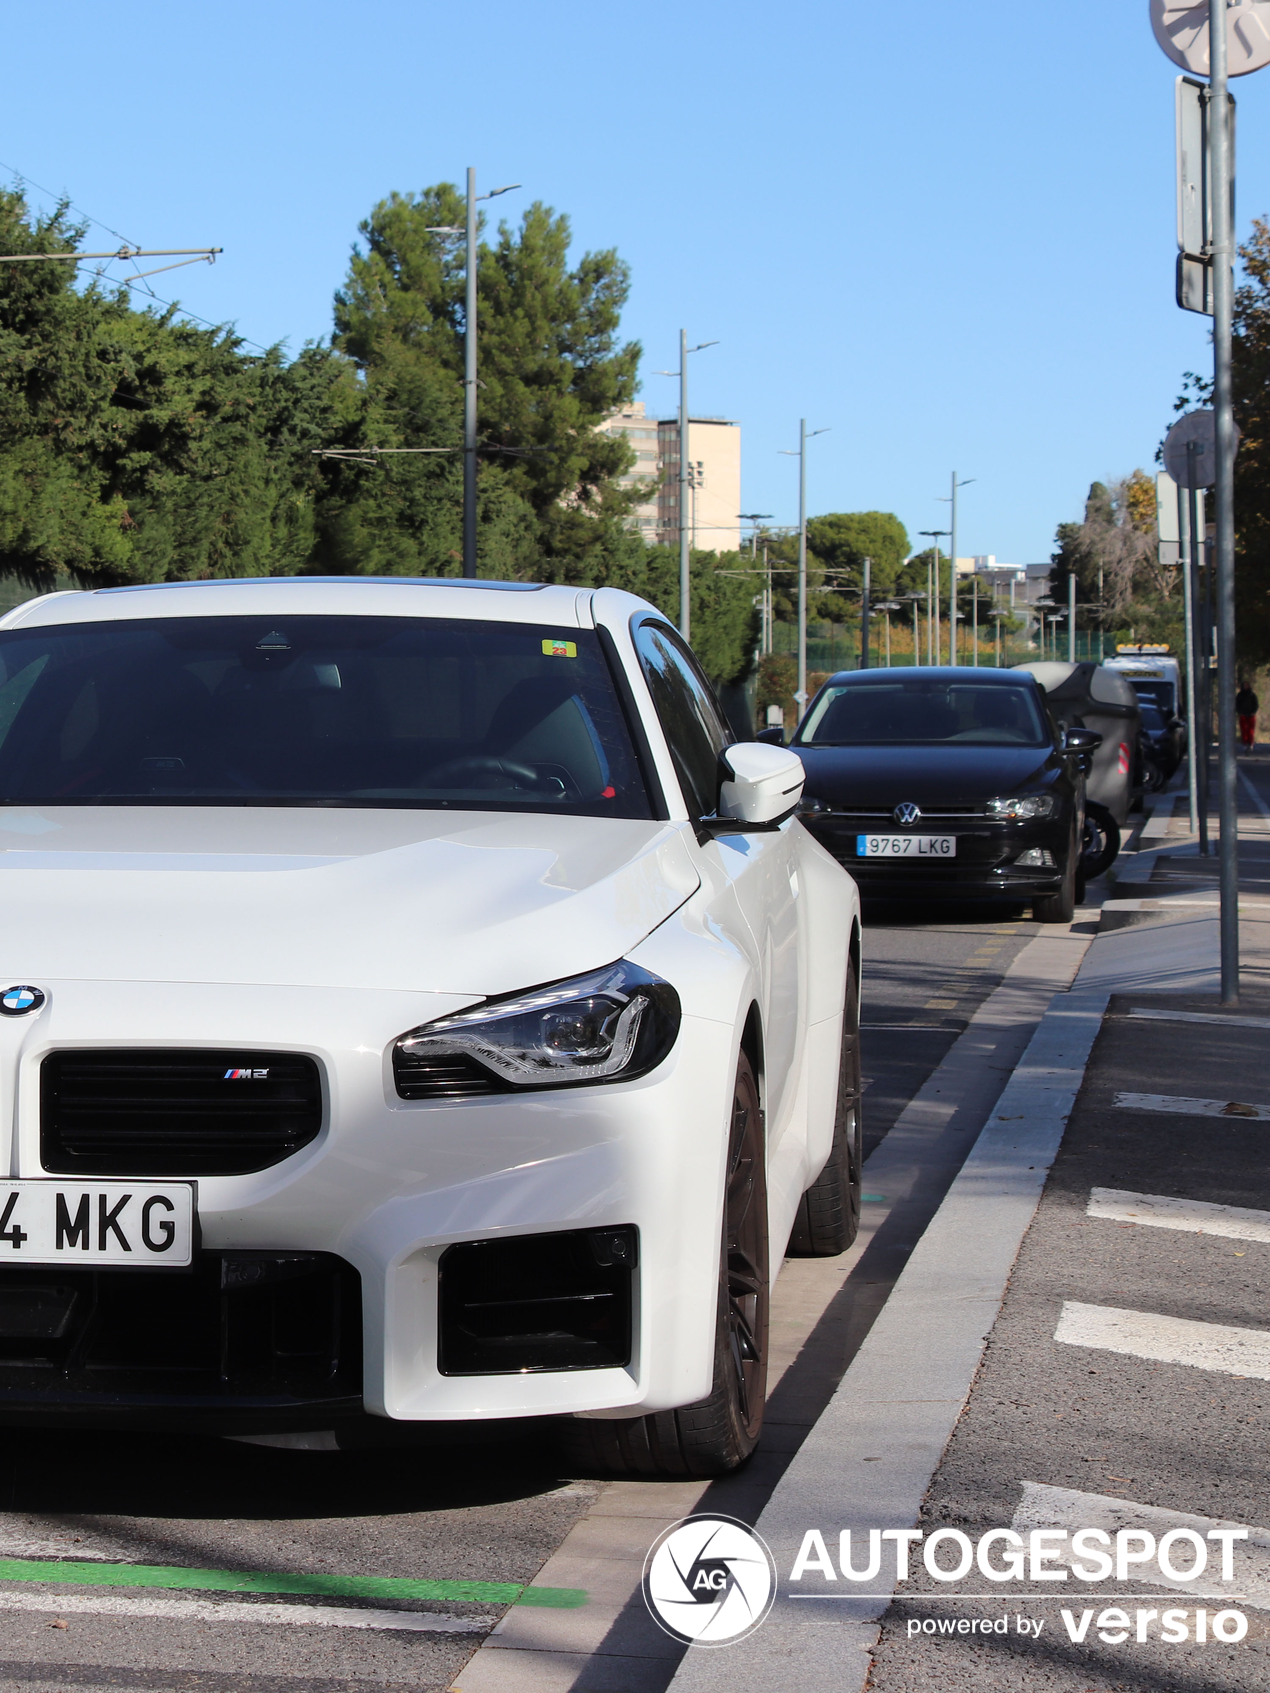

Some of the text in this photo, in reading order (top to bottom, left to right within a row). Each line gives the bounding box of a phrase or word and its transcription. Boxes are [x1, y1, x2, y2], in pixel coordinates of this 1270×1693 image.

[552, 647, 567, 655] 23
[870, 839, 951, 854] 9767 LKG
[234, 1068, 269, 1079] M2
[55, 1192, 175, 1252] MKG
